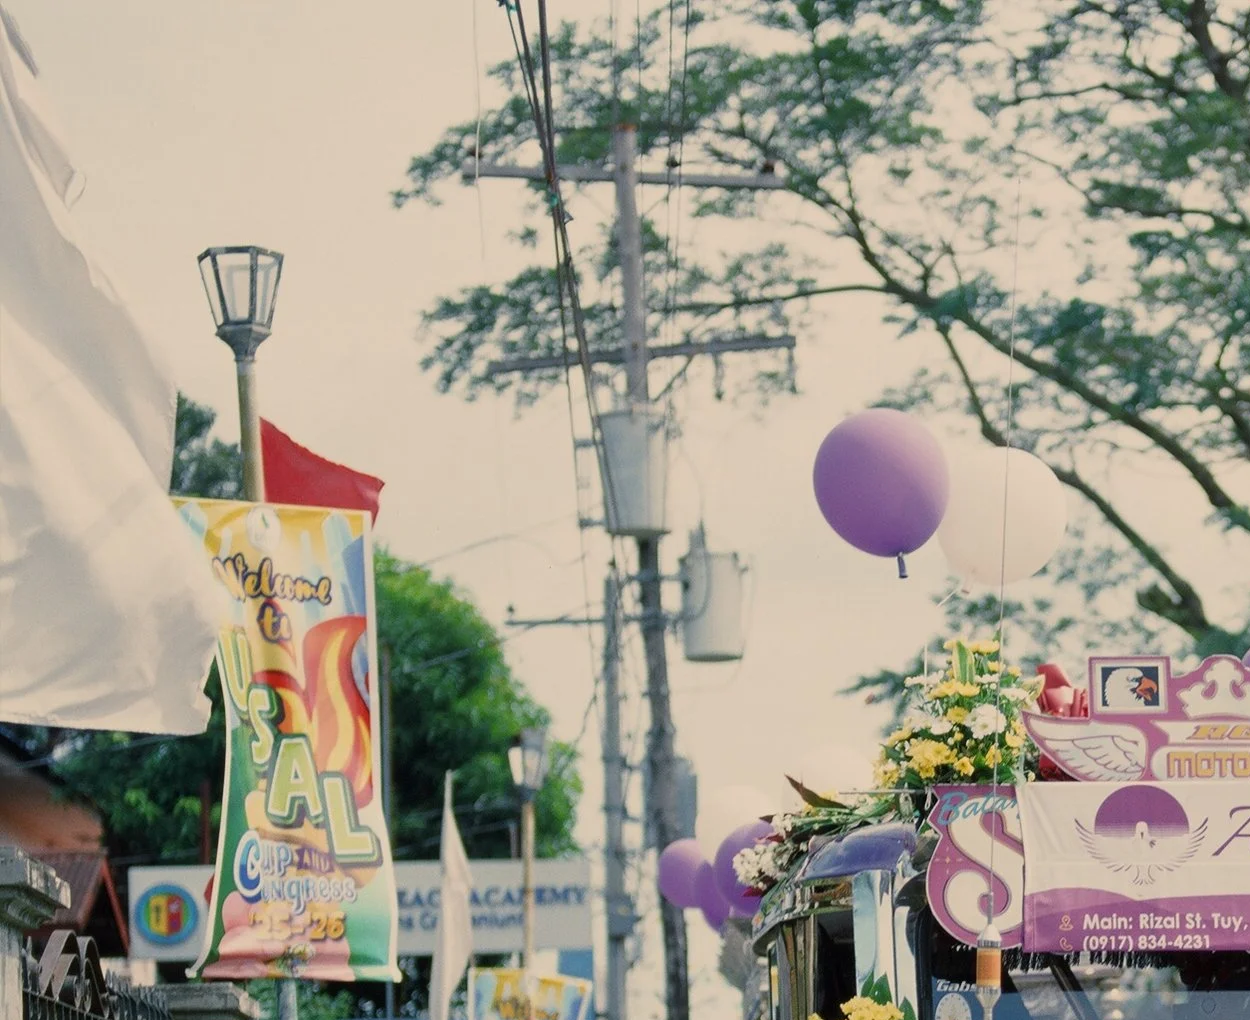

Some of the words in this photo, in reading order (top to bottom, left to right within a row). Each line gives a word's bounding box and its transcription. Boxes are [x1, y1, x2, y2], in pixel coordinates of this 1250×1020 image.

[1082, 913, 1133, 931] Main:
[1139, 913, 1180, 930] Rizal
[1185, 913, 1206, 930] St.
[1211, 913, 1249, 932] Tuy,
[1082, 935, 1134, 951] (0917)
[1138, 934, 1211, 950] 834-4231
